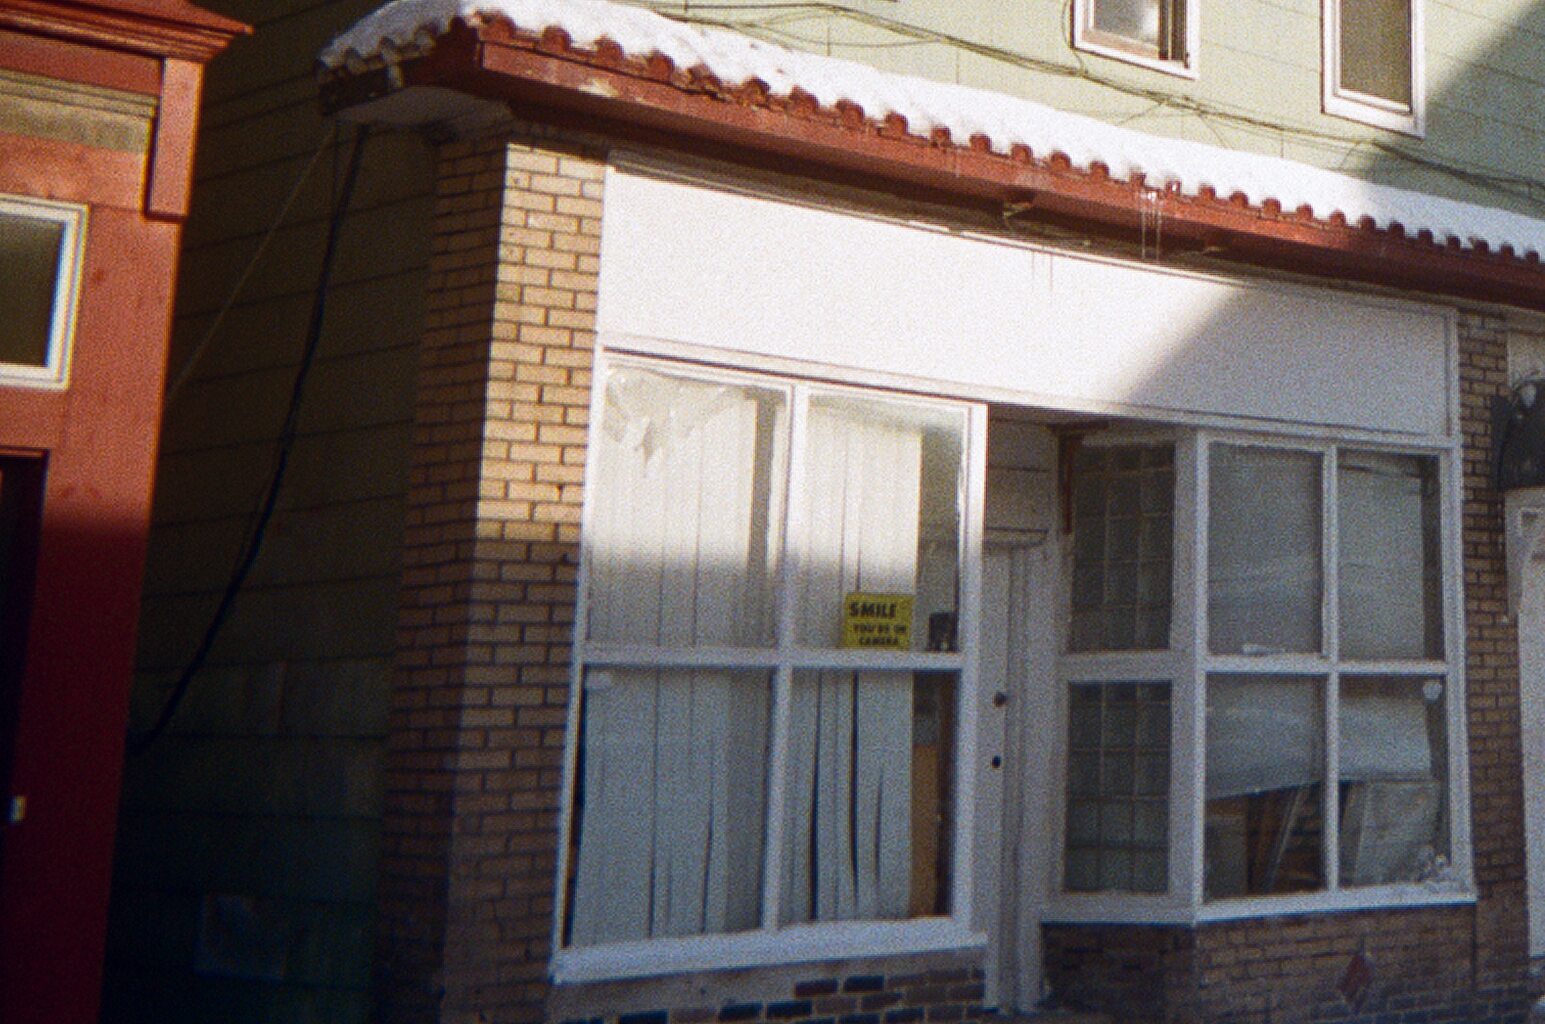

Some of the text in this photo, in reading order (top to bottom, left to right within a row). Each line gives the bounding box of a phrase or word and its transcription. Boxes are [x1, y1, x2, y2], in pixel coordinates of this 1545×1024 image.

[849, 601, 897, 618] SMILE
[893, 623, 907, 634] ON
[858, 635, 899, 646] CAMERA
